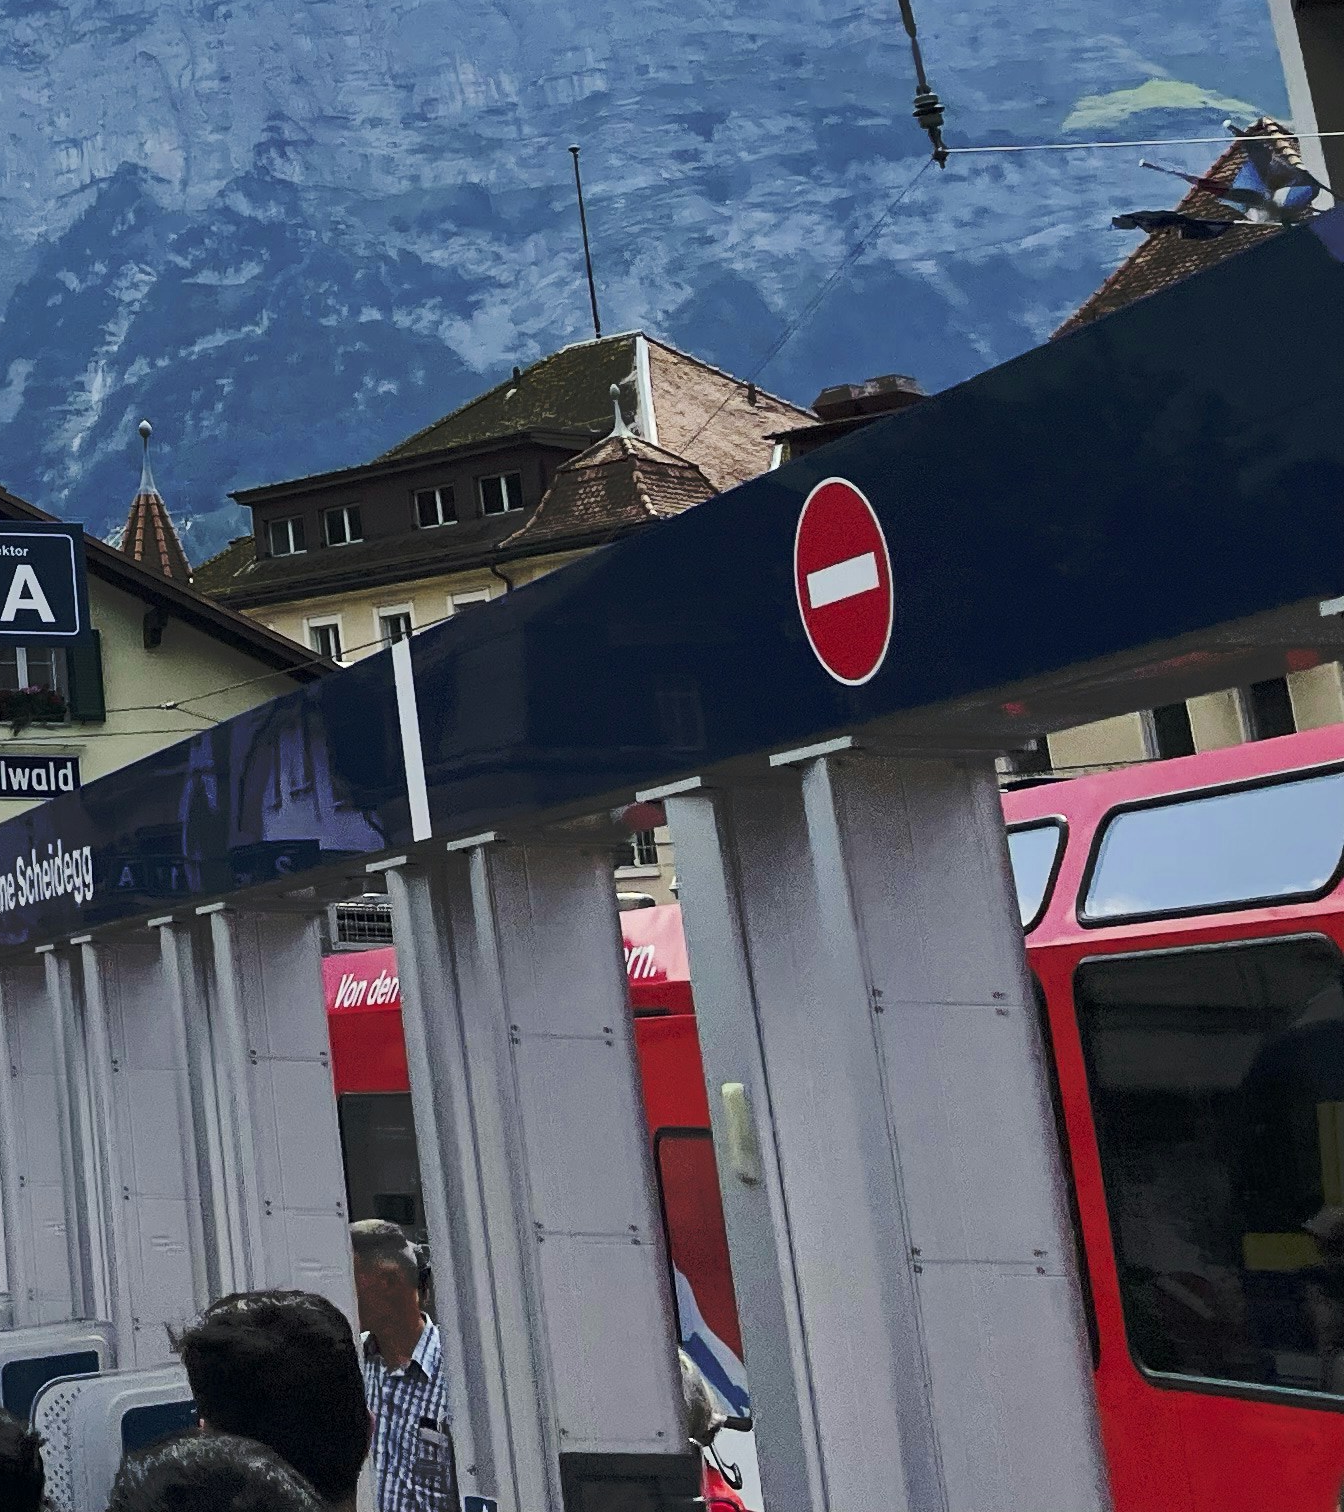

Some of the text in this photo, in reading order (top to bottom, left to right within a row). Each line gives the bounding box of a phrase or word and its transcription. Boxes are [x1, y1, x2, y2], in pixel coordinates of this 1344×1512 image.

[0, 564, 56, 623] A
[16, 838, 95, 907] Scheidegg
[334, 973, 368, 1009] Von
[366, 969, 400, 1006] den
